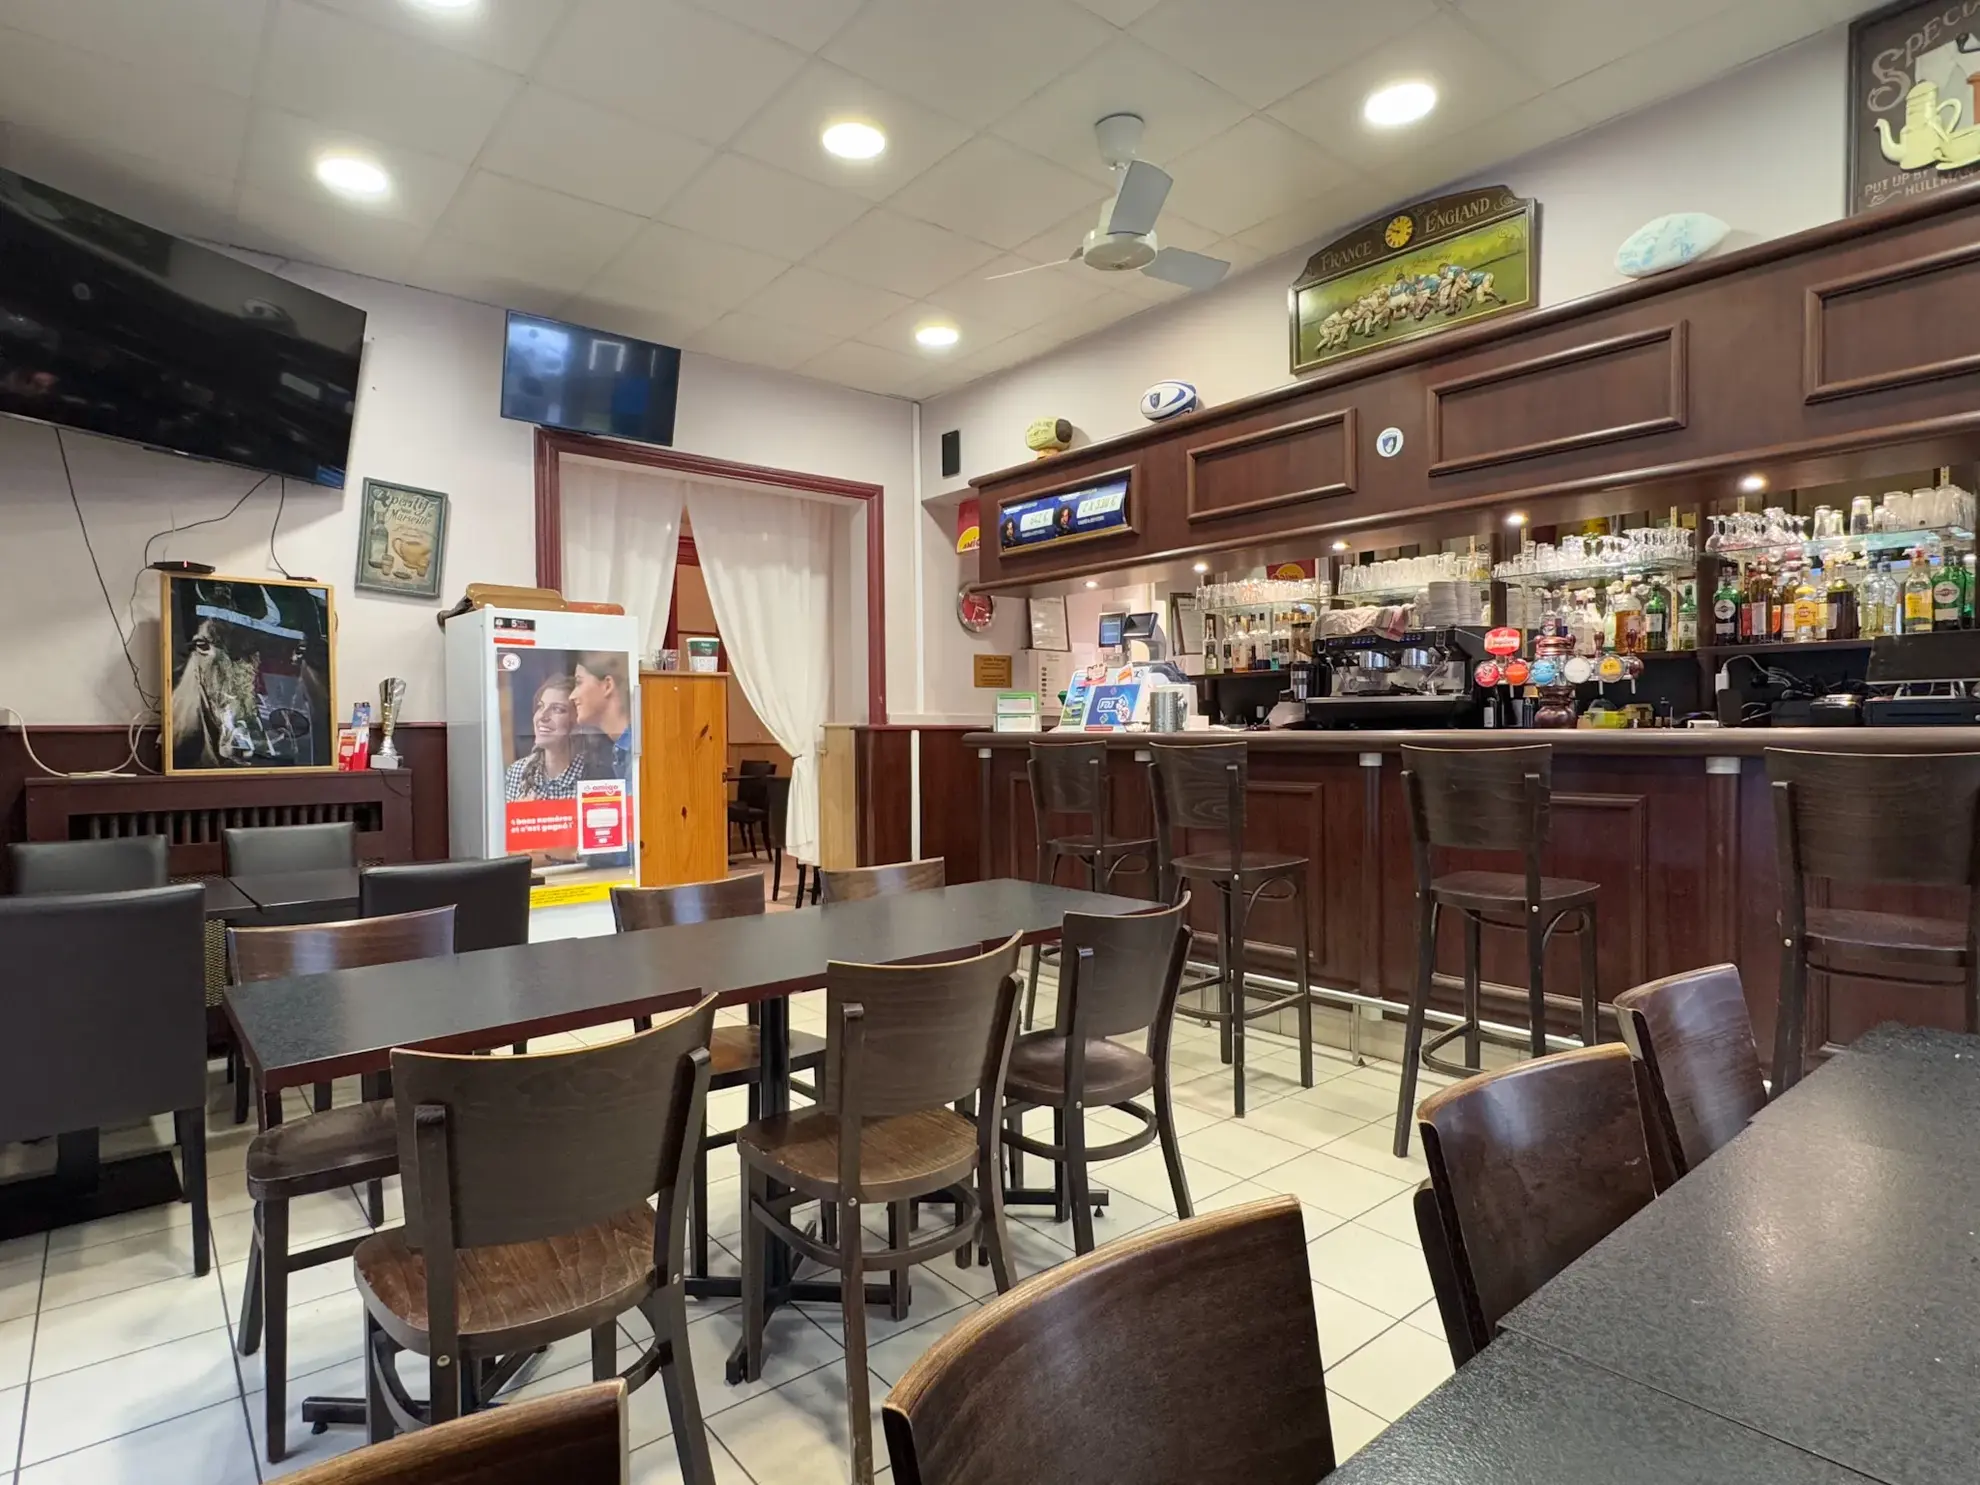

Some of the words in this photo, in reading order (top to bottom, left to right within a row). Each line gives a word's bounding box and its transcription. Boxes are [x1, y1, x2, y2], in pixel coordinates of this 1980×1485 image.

[1864, 178, 1889, 197] PUT
[1892, 172, 1910, 188] UP
[1424, 197, 1490, 234] ENGLAND
[1320, 240, 1372, 271] FRANCE
[511, 619, 517, 628] 5
